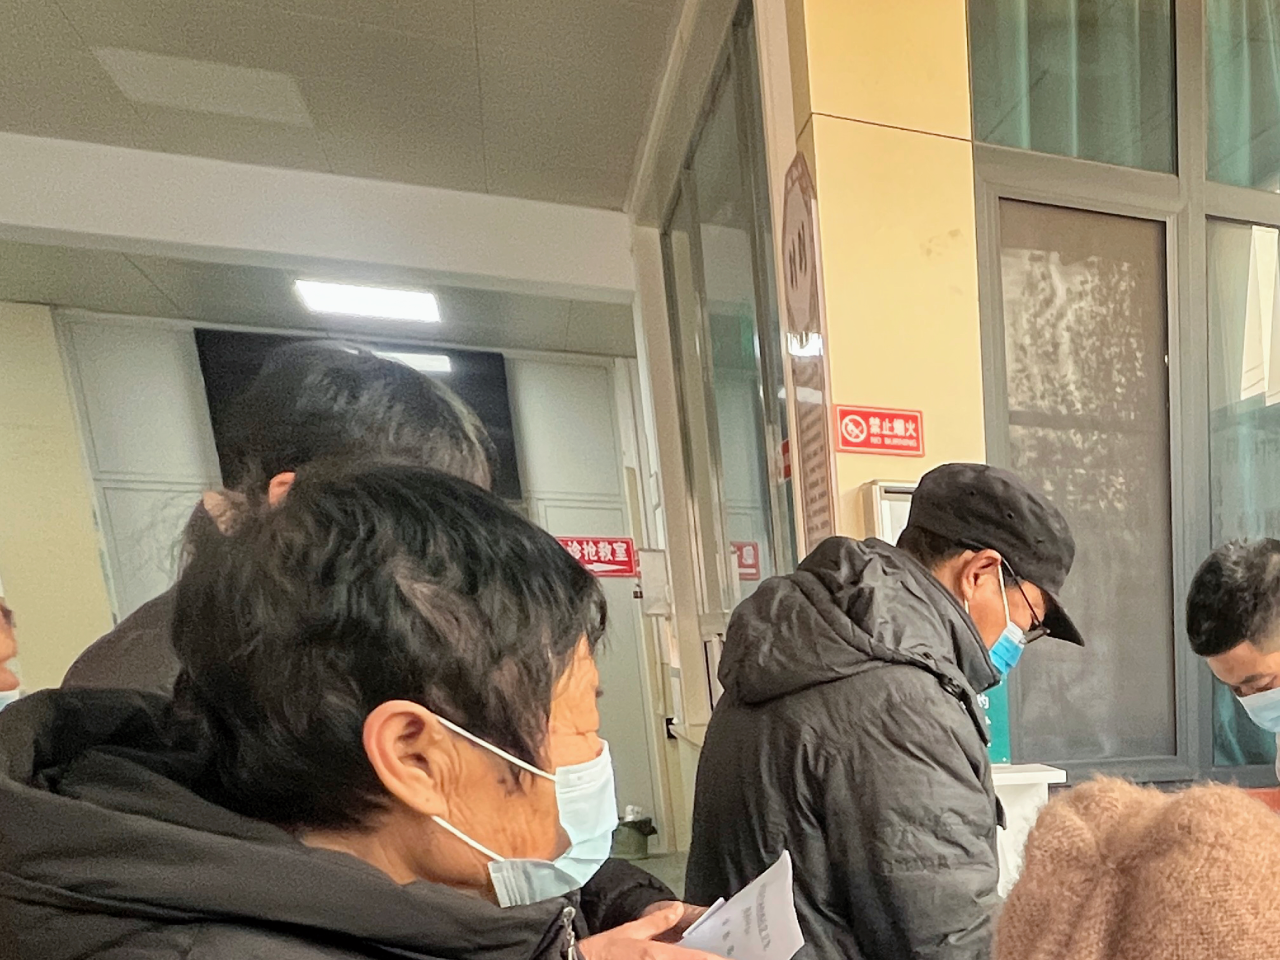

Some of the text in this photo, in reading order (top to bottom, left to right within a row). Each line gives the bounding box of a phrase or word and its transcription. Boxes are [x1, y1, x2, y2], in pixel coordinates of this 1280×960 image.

[869, 416, 917, 437] 禁止烟火
[870, 436, 917, 448] NO BURNING
